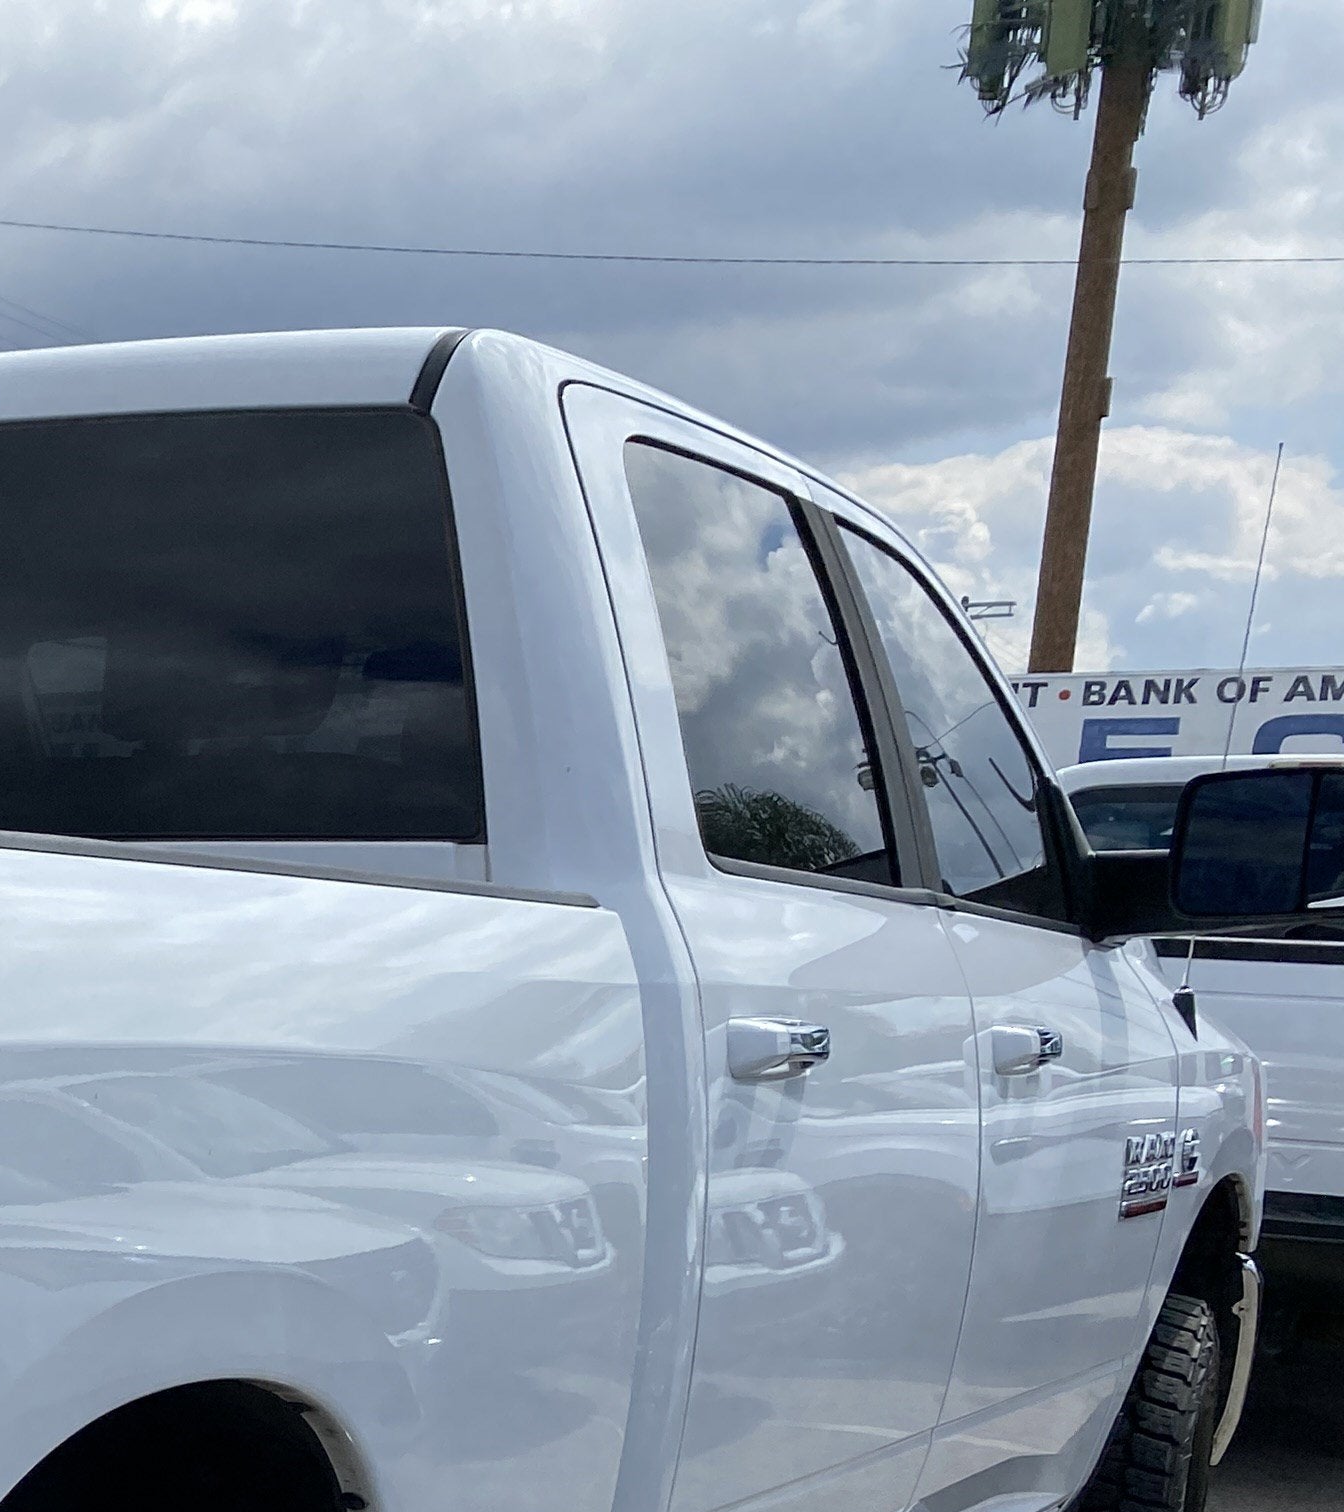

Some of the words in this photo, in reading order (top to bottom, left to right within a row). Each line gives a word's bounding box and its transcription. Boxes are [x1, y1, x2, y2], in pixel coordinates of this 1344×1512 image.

[1082, 677, 1201, 707] BANK
[1216, 676, 1274, 704] OF
[1124, 1130, 1177, 1166] RAM
